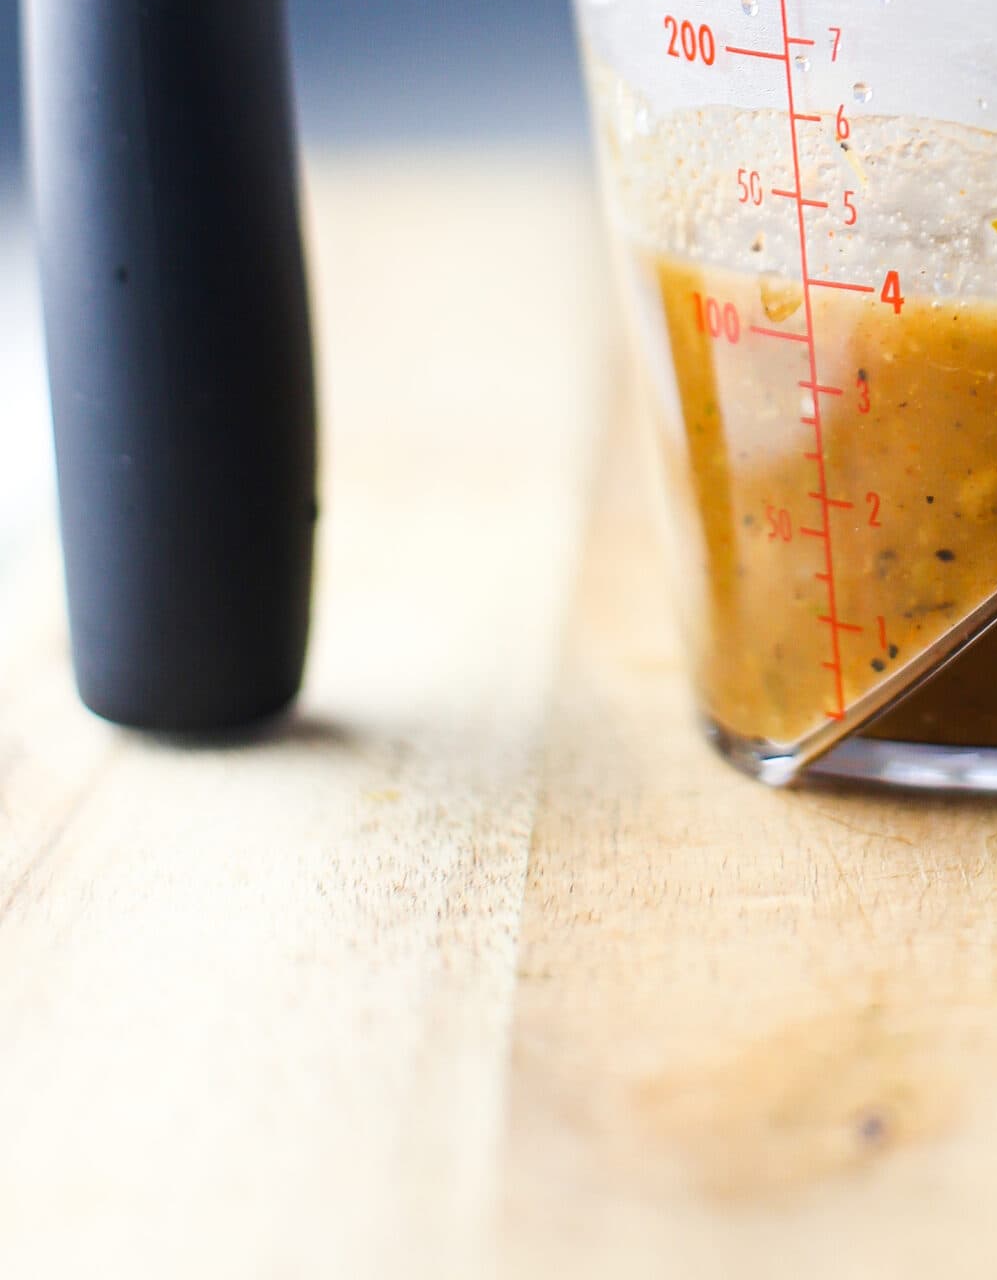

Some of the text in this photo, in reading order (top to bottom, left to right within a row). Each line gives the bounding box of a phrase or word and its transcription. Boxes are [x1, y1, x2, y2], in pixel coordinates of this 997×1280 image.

[664, 15, 716, 66] 200
[828, 27, 842, 62] 7
[836, 104, 849, 140] 6
[737, 168, 763, 206] 50
[843, 191, 857, 225] 5
[880, 270, 905, 314] 4
[693, 292, 740, 344] 100
[856, 376, 870, 413] 3
[764, 505, 793, 543] 50
[865, 491, 881, 527] 2
[877, 615, 887, 649] 1
